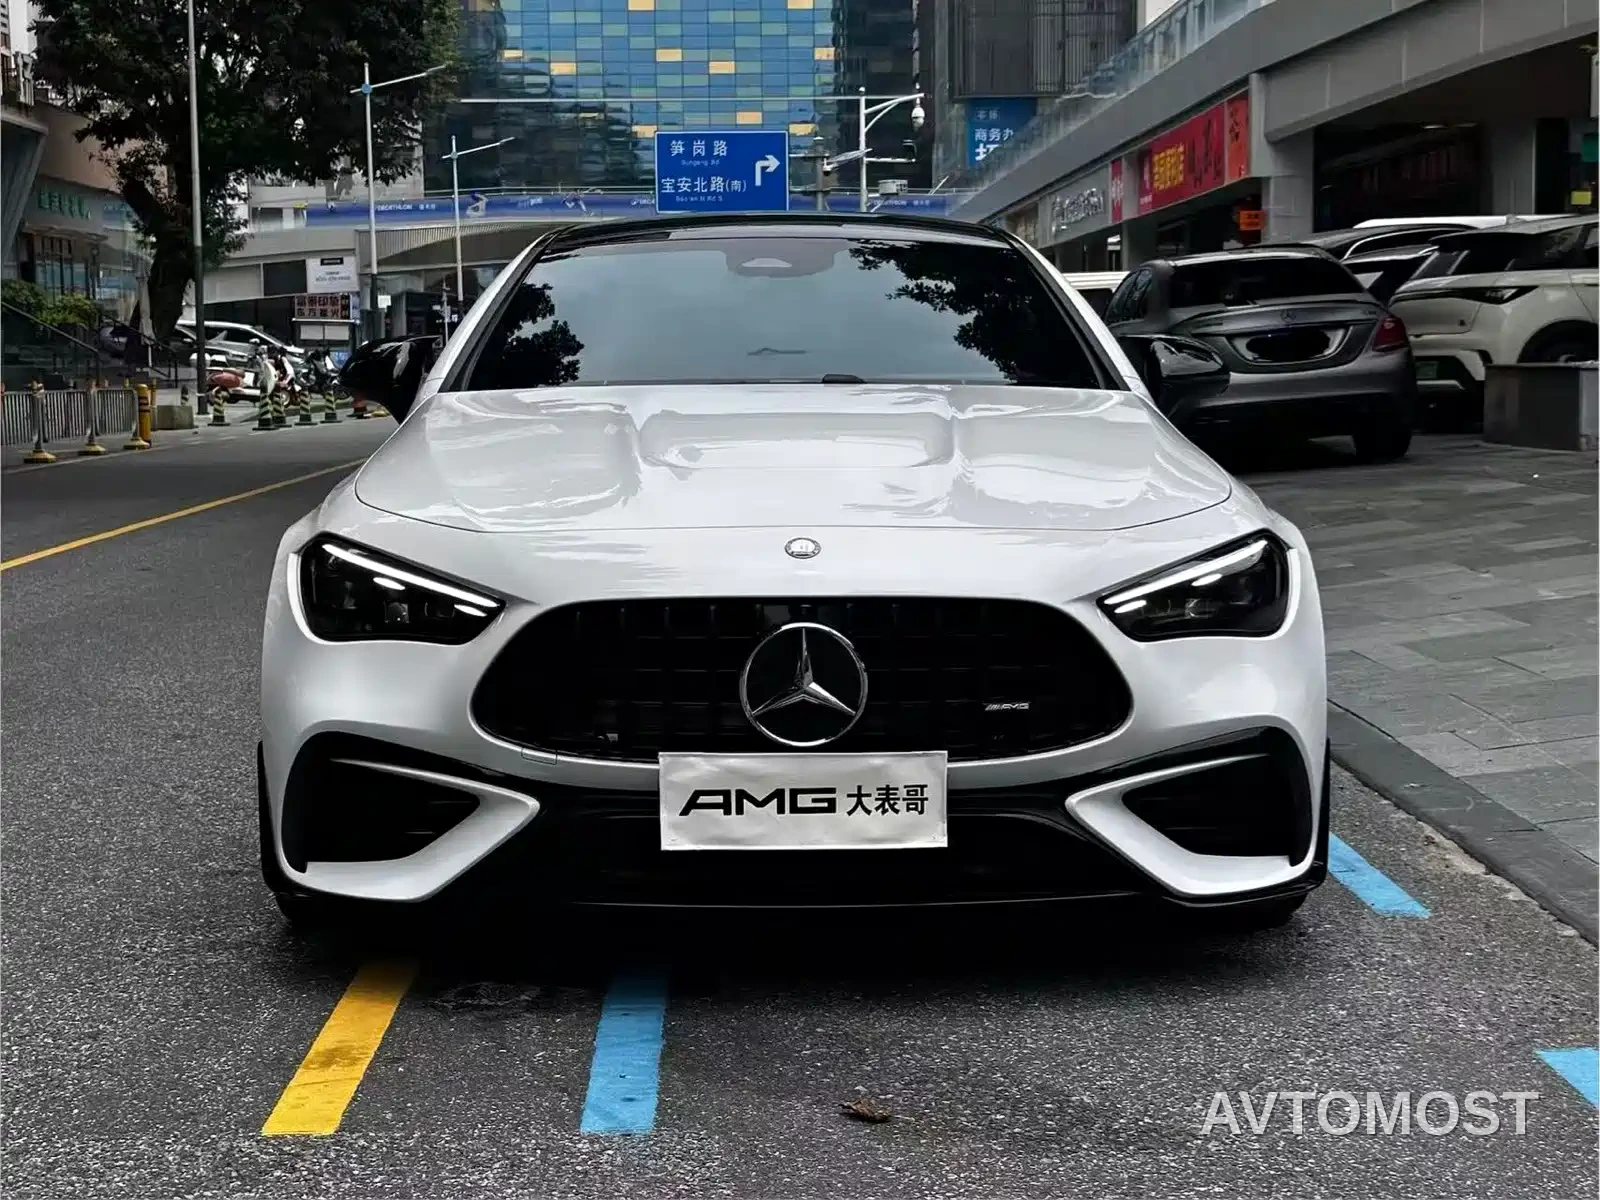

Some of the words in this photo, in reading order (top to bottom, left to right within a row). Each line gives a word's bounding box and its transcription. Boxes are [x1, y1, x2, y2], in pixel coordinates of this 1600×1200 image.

[670, 140, 728, 157] 笋岗路
[661, 176, 747, 193] 宝安北路(南)
[678, 787, 837, 816] AMG
[846, 784, 929, 816] 大表哥
